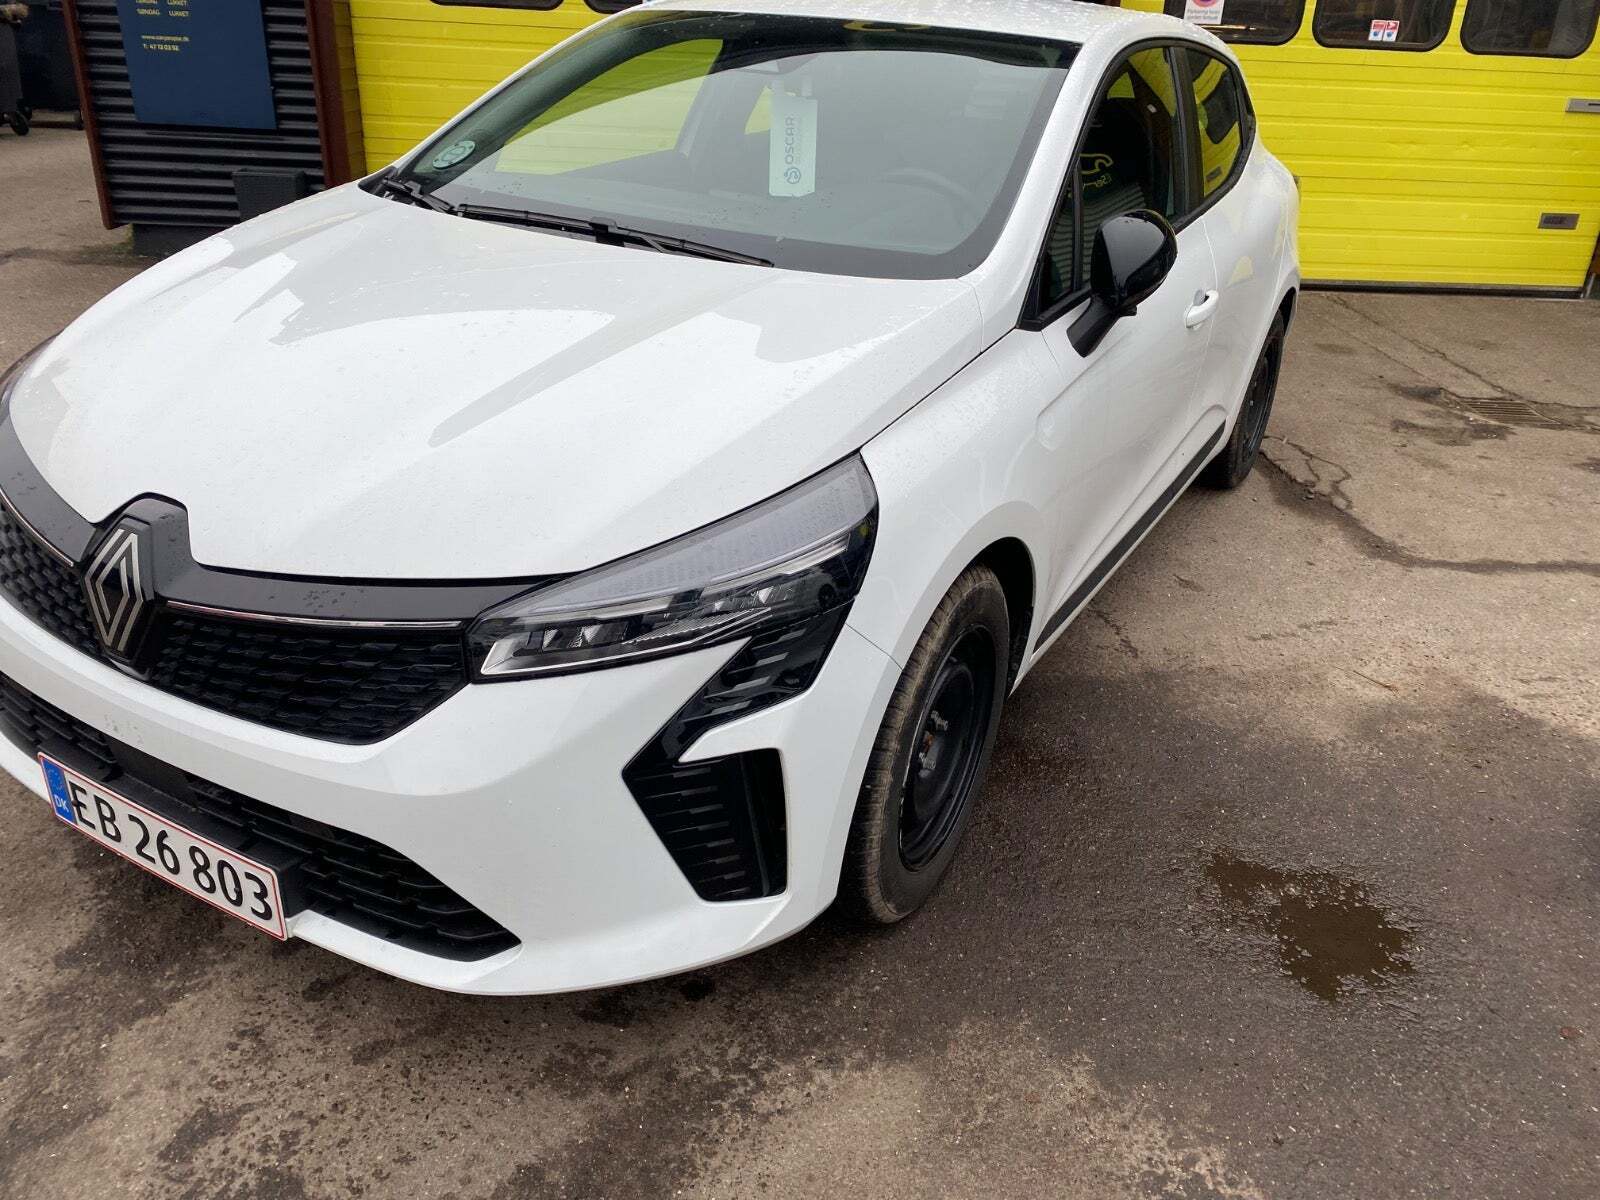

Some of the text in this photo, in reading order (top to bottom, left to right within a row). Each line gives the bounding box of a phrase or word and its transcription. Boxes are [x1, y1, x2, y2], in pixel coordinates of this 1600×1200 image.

[784, 115, 796, 165] OSCAR
[54, 794, 70, 813] DK
[68, 780, 273, 921] EB 26 803
